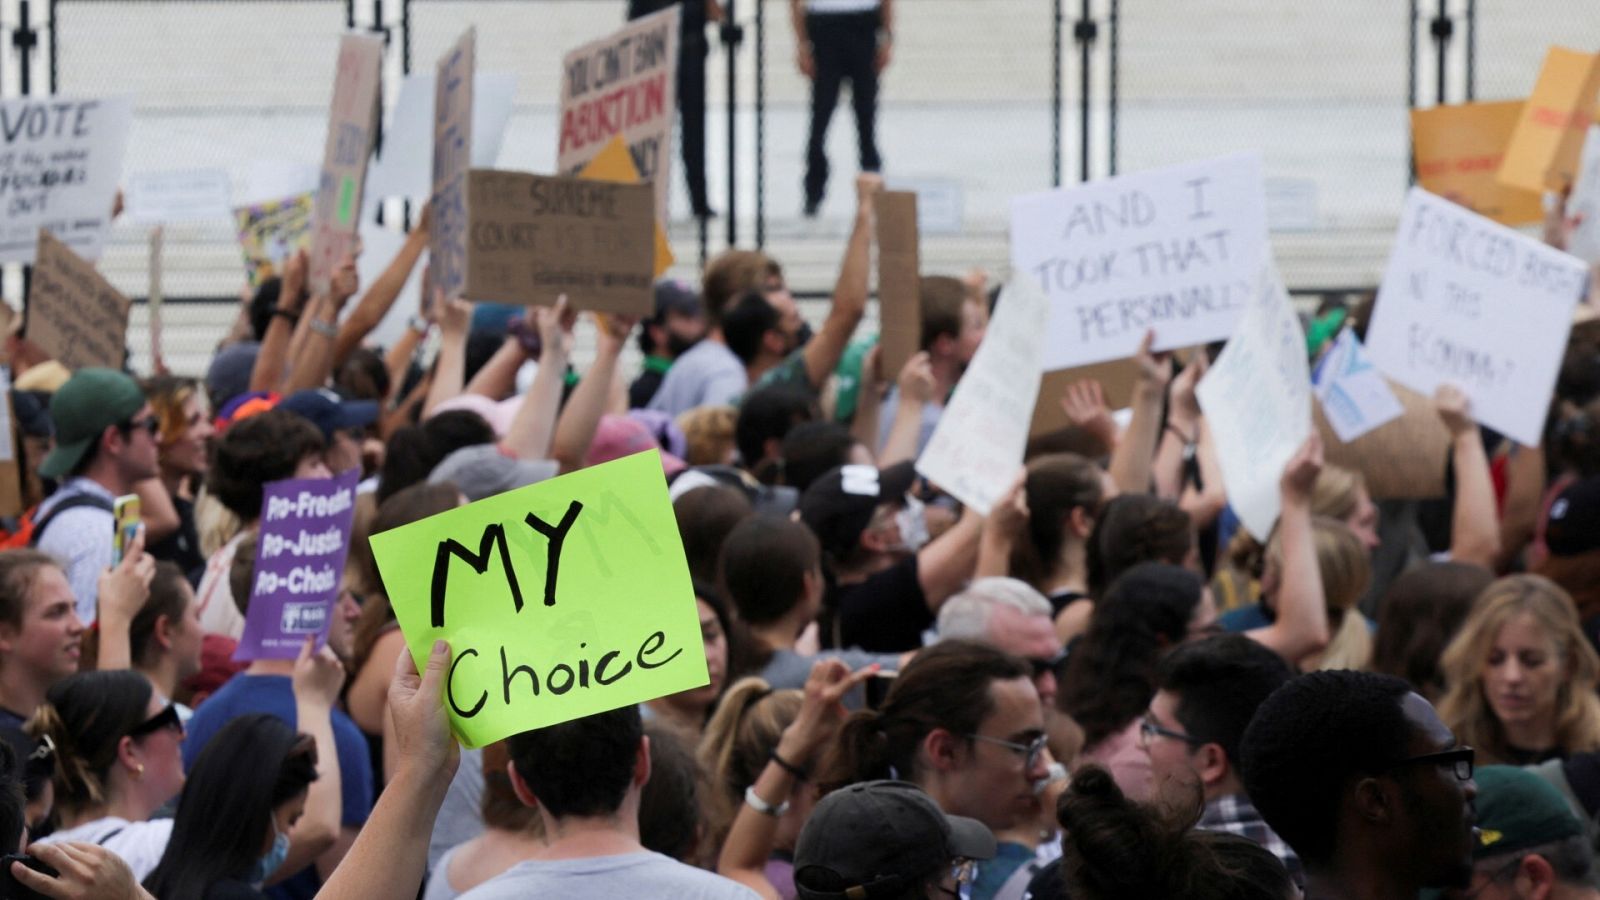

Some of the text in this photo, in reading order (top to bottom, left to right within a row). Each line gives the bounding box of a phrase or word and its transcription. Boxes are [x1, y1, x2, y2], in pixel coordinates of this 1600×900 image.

[0, 100, 100, 144] VOTE
[1063, 176, 1214, 241] AND I
[1408, 204, 1516, 276] FORCED
[1034, 228, 1231, 295] TOOK THAT
[431, 500, 583, 627] MY
[448, 631, 683, 718] Choice
